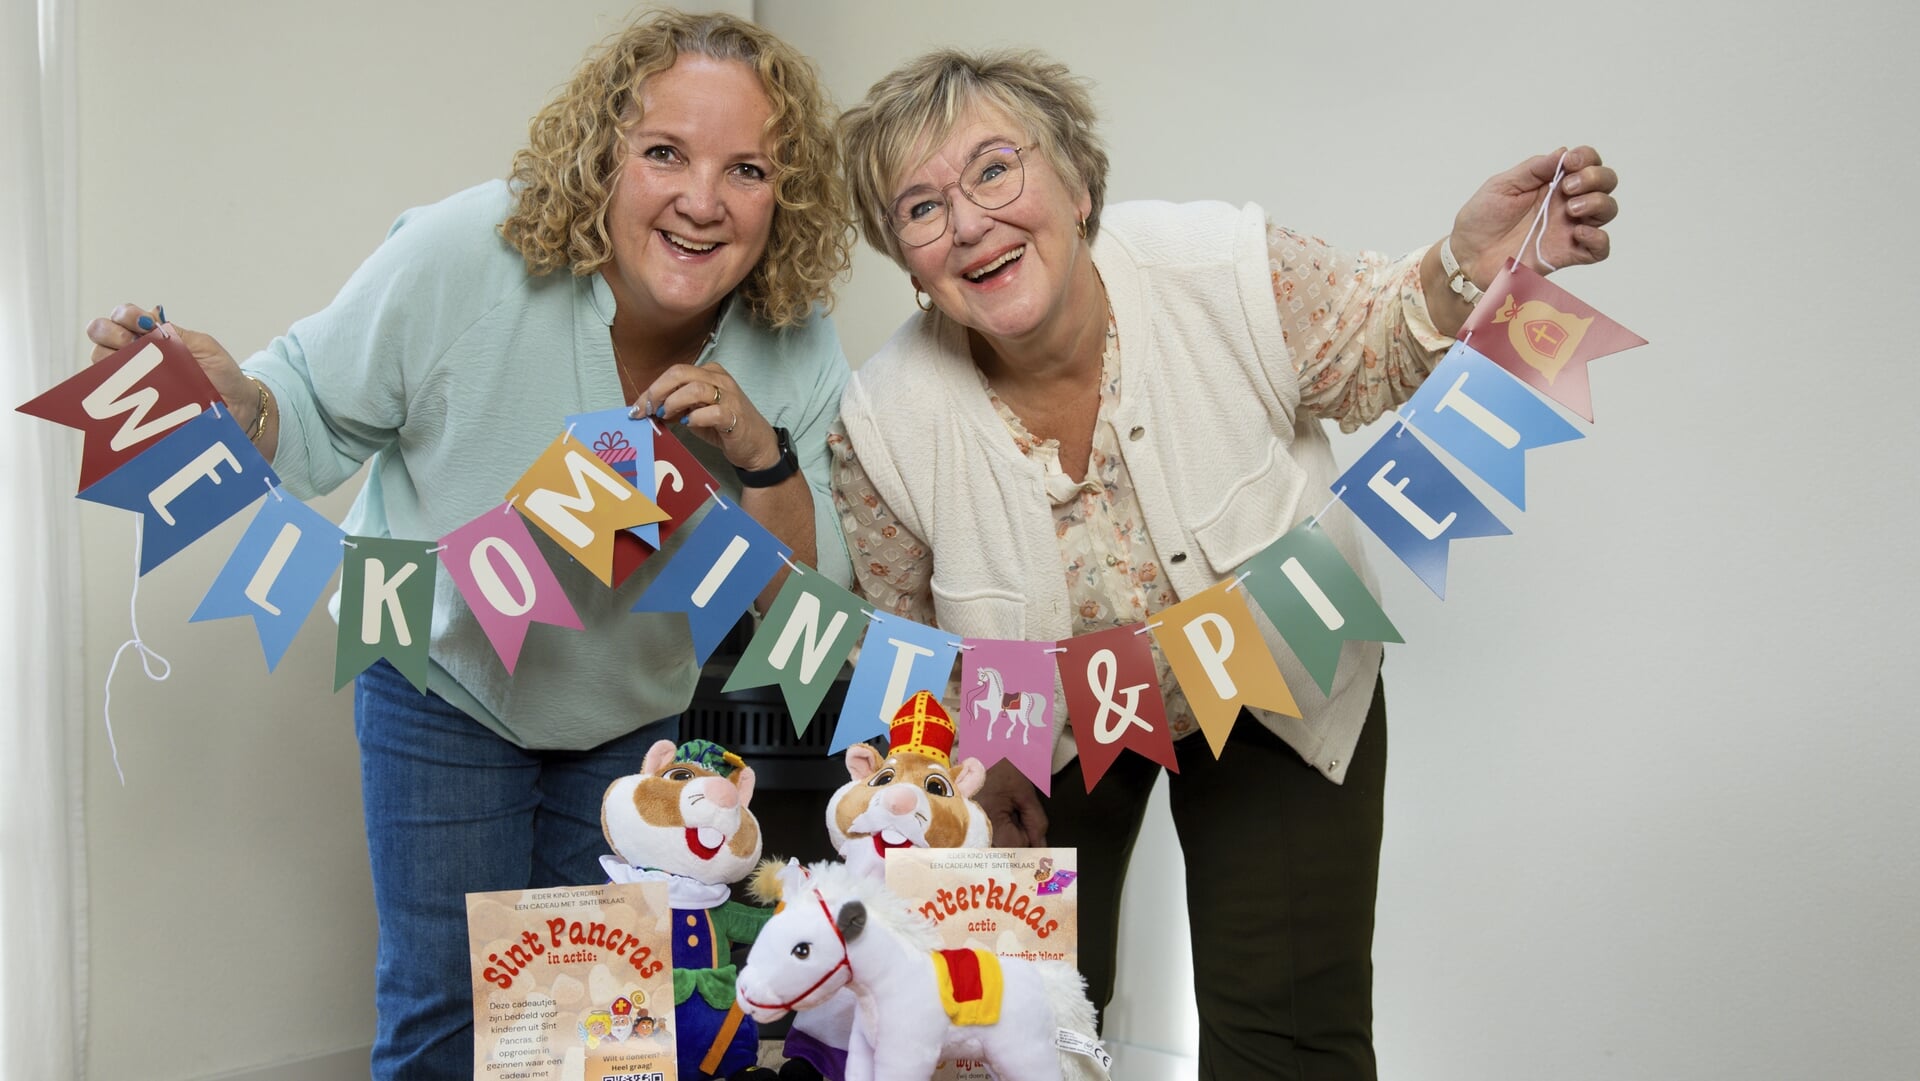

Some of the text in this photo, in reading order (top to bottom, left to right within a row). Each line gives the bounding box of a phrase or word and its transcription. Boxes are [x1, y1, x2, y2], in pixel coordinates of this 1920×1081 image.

[81, 342, 631, 646] WELKOM
[1090, 649, 1154, 745] &
[1182, 370, 1521, 699] PIET
[531, 889, 605, 900] IEDER KIND VERDIENT
[514, 897, 626, 911] EEN CADEAU MET SINTERKLAAS
[904, 877, 1059, 939] nterklaas
[483, 917, 664, 989] Sint Pancras
[547, 951, 561, 965] in
[489, 999, 557, 1010] Deze cadeautjes
[488, 1014, 503, 1023] zijn
[504, 1012, 539, 1021] bedoeld
[490, 1022, 557, 1034] kinderen uit Sint
[535, 1034, 549, 1043] die
[498, 1047, 541, 1058] opgroeien
[602, 1054, 618, 1062] Wilt
[486, 1058, 563, 1072] gezinnen waar een
[611, 1062, 653, 1071] Heel graag!
[499, 1070, 549, 1080] cadeau met
